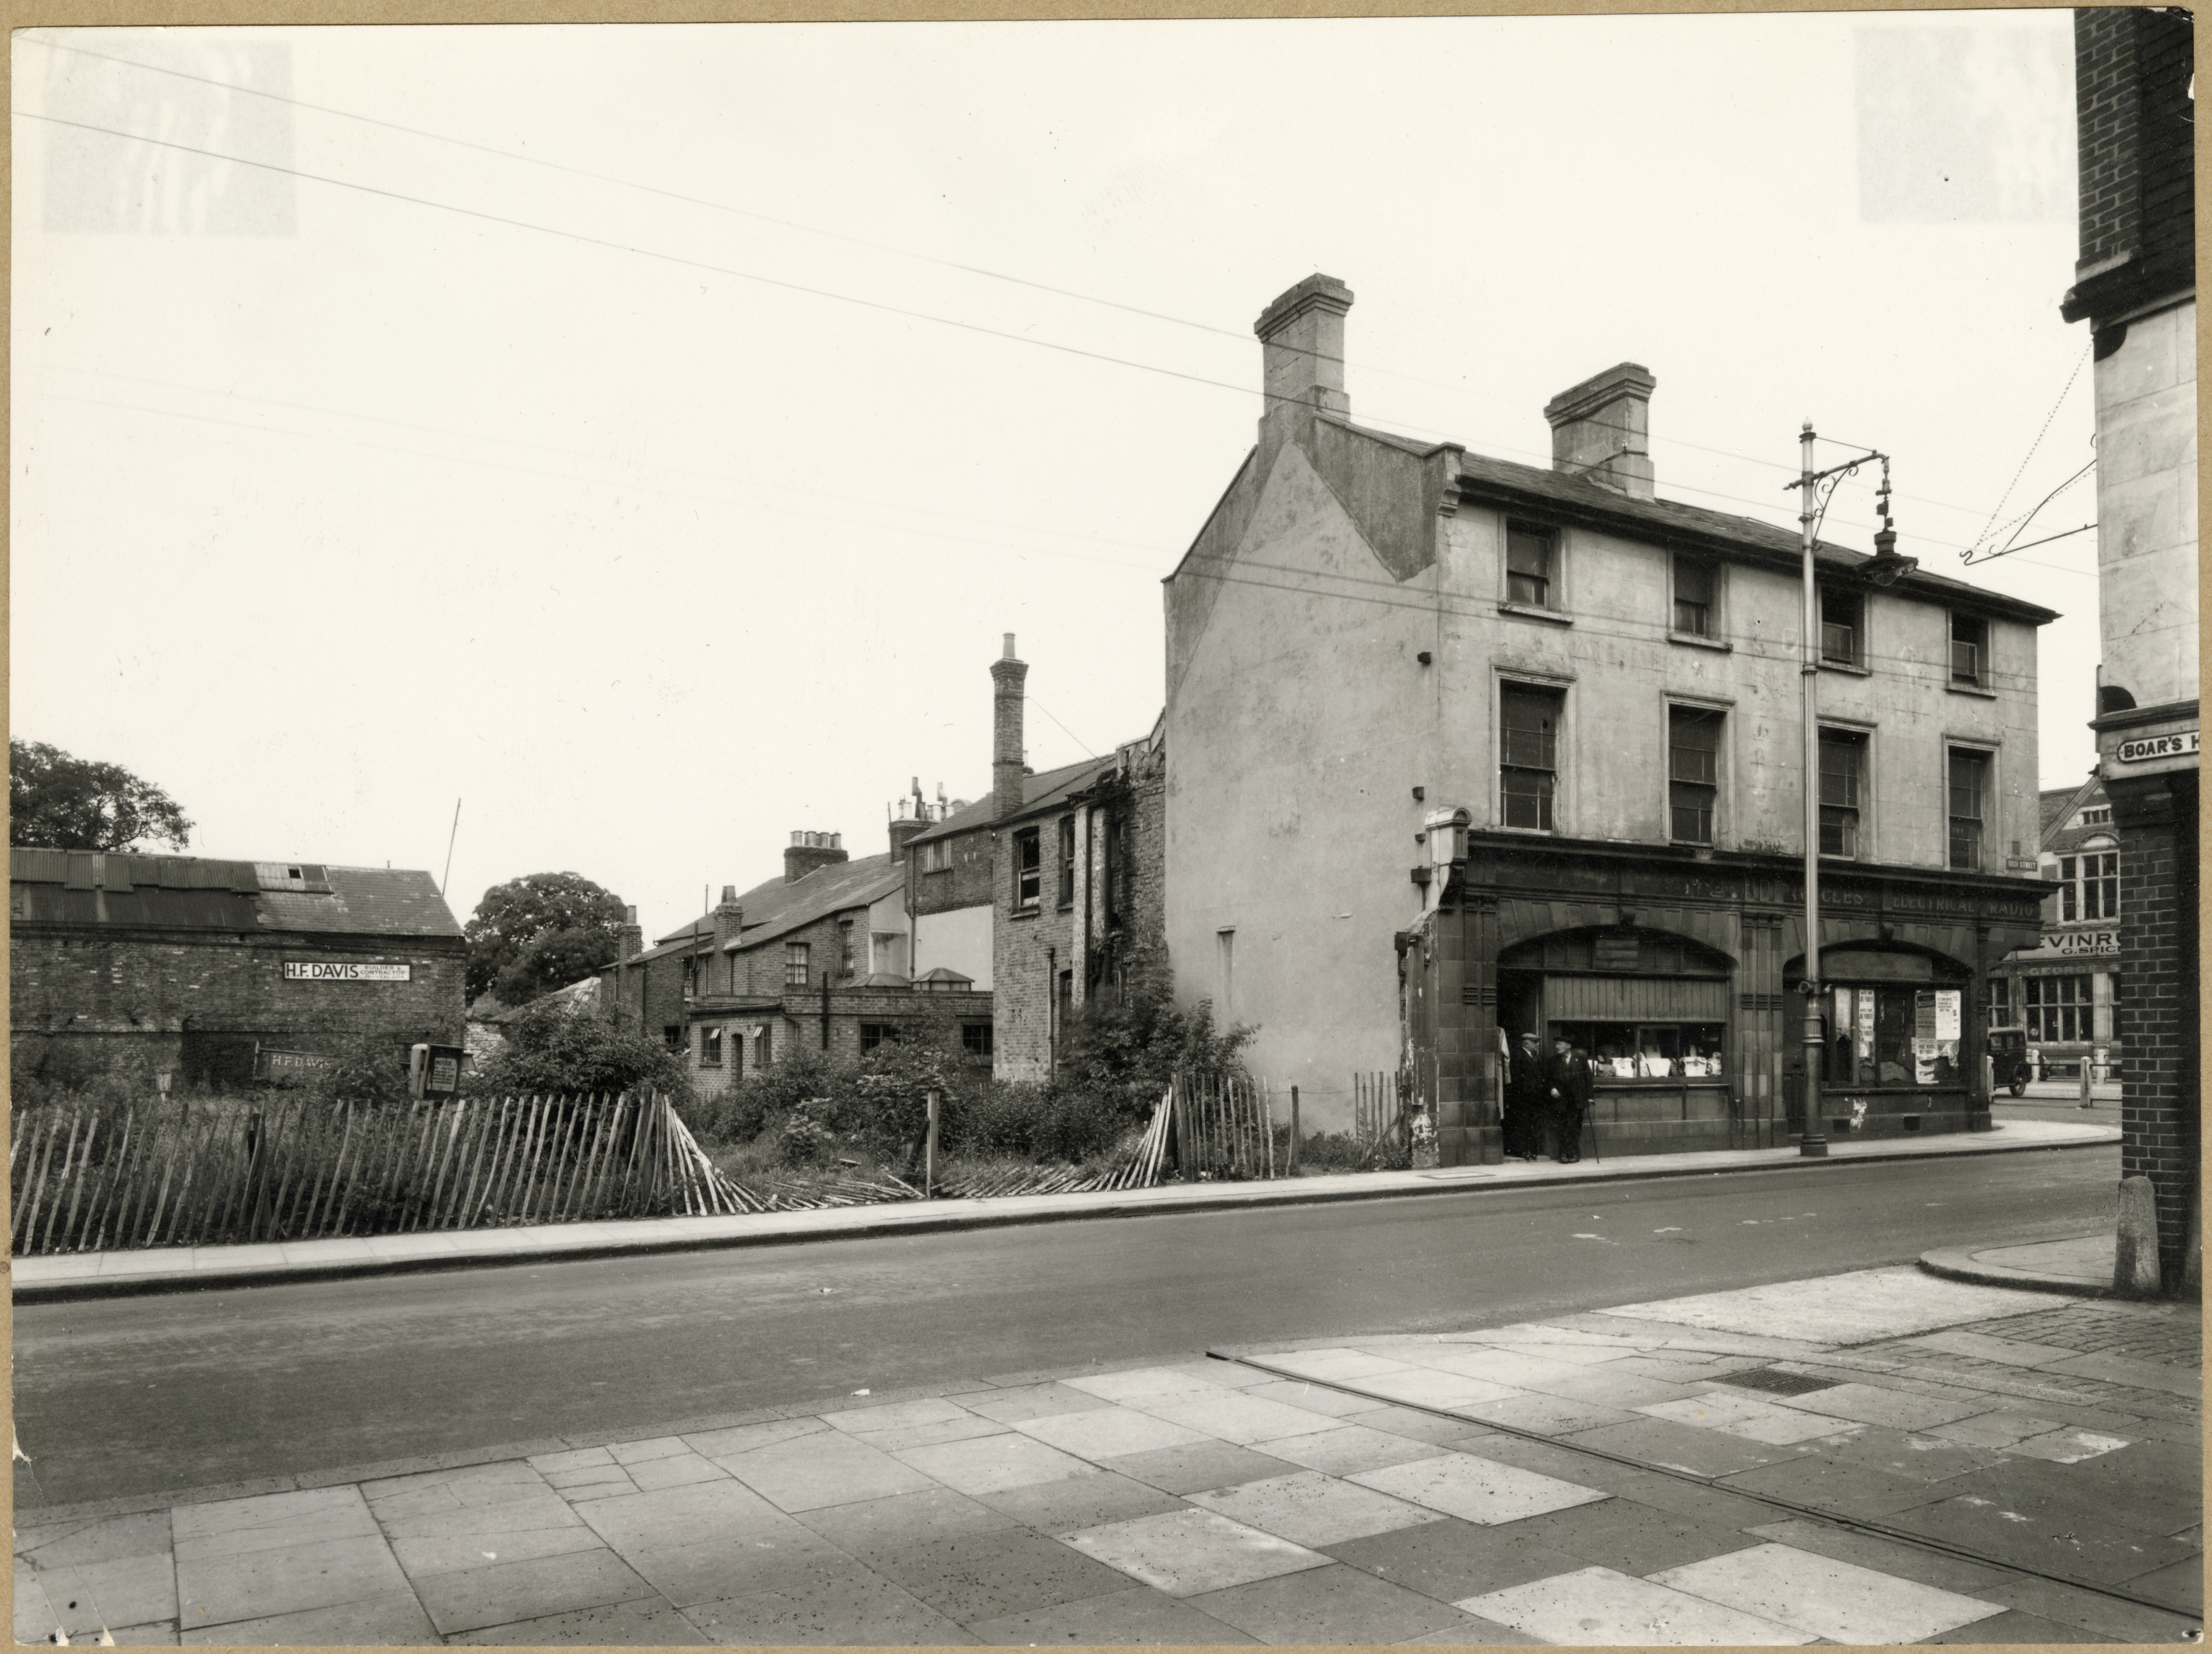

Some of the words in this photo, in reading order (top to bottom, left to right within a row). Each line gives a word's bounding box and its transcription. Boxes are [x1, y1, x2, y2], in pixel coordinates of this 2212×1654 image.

[2124, 736, 2183, 758] BOAR'S
[2019, 861, 2036, 869] STREET
[1893, 897, 1975, 912] ELECTRICAL
[1990, 902, 2033, 916] RADIO
[312, 965, 359, 978] DAVIS
[295, 1057, 330, 1069] DAVIS
